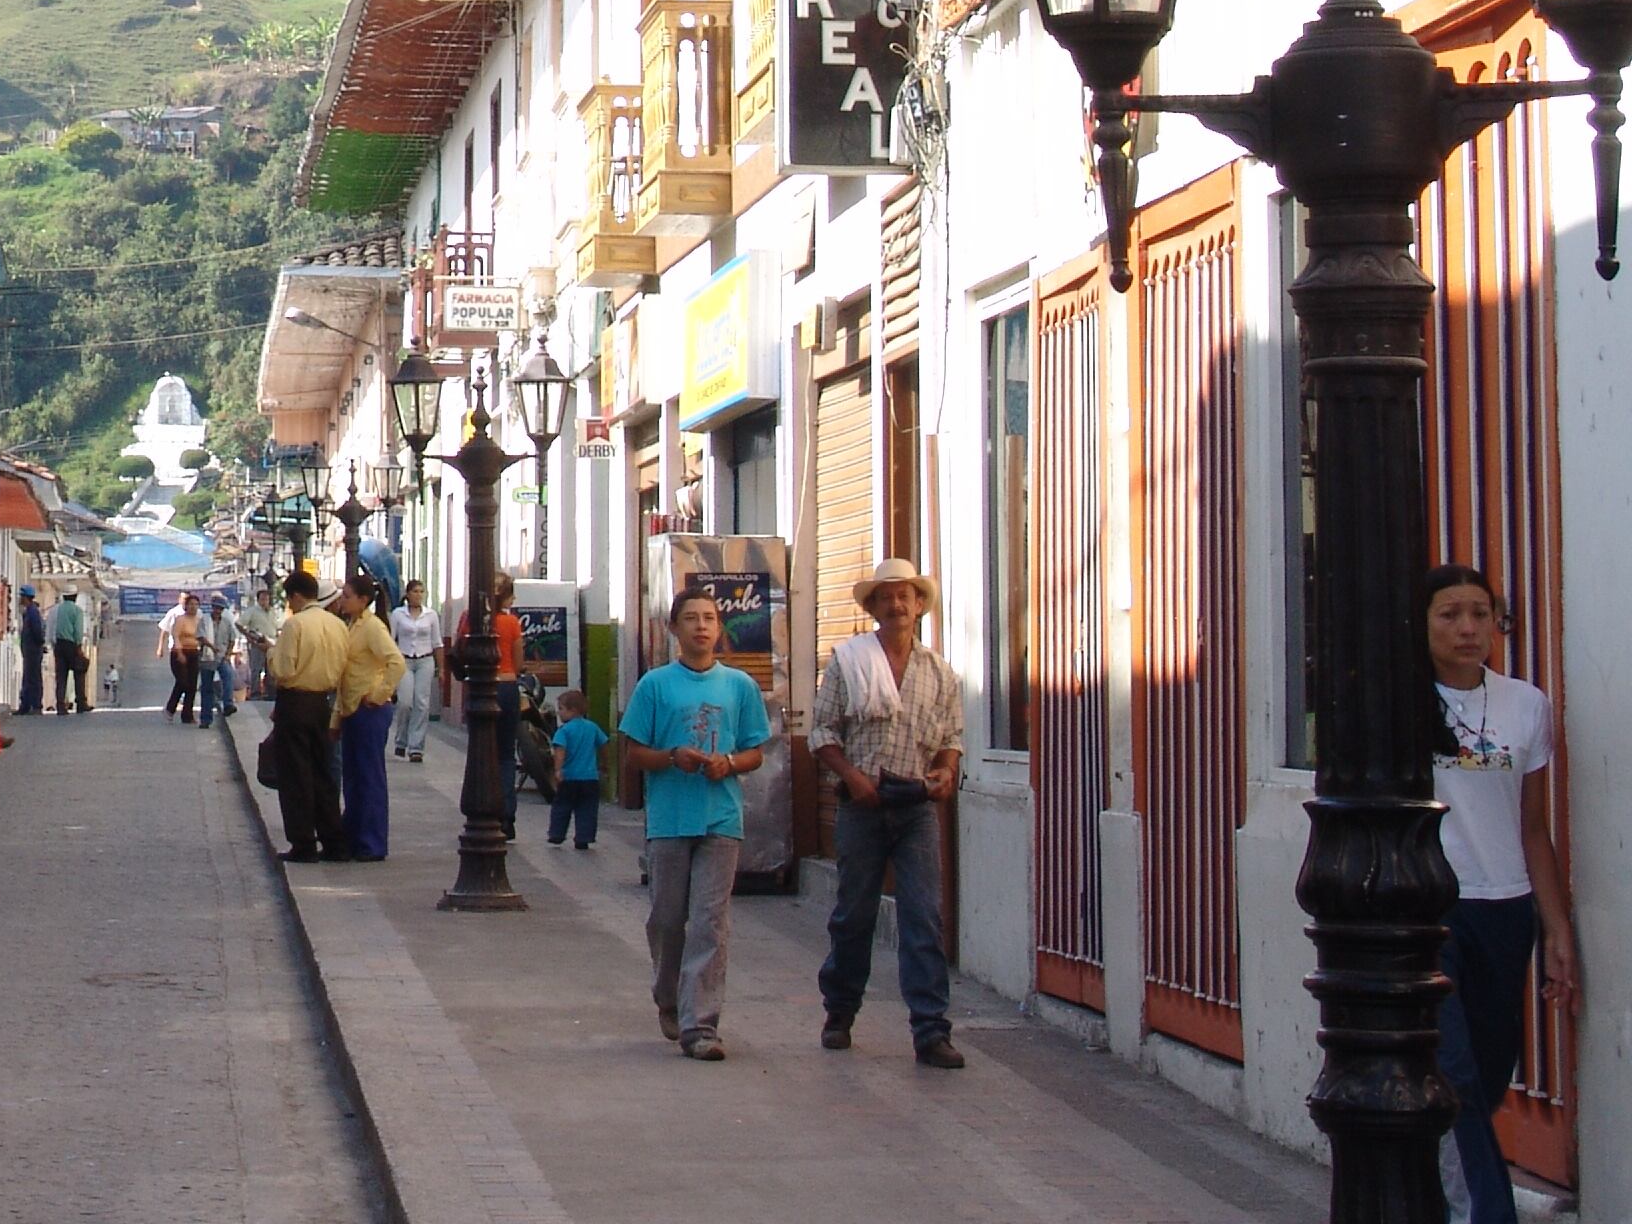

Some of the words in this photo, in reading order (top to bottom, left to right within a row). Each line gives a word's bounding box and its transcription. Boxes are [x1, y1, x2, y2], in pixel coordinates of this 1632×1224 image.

[452, 293, 514, 304] FARMACIA
[452, 307, 515, 319] POPULAR
[578, 444, 618, 458] DERBY
[519, 614, 562, 635] Caribe
